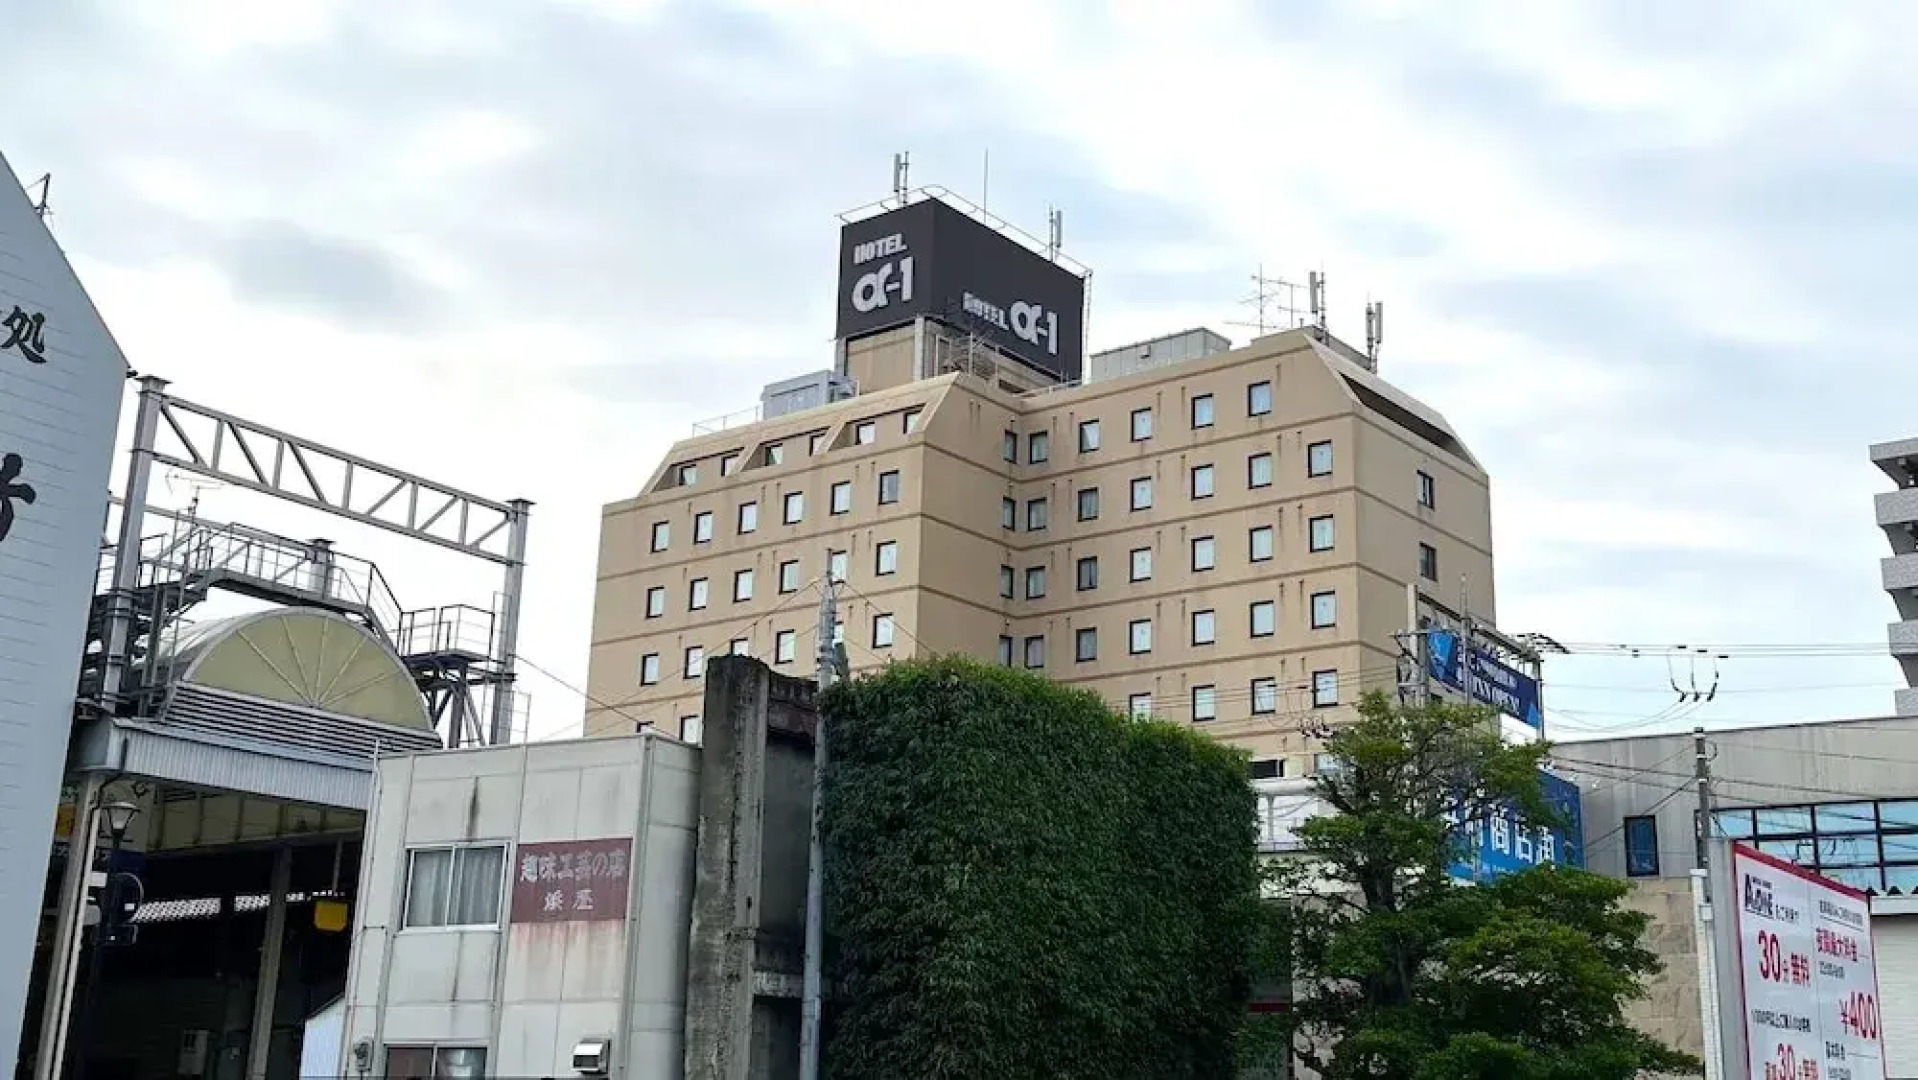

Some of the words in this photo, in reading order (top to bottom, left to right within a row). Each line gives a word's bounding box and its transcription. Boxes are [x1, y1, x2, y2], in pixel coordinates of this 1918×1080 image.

[854, 233, 908, 265] HOTEL
[963, 292, 1010, 331] HOTEL
[1839, 991, 1878, 1040] ¥400
